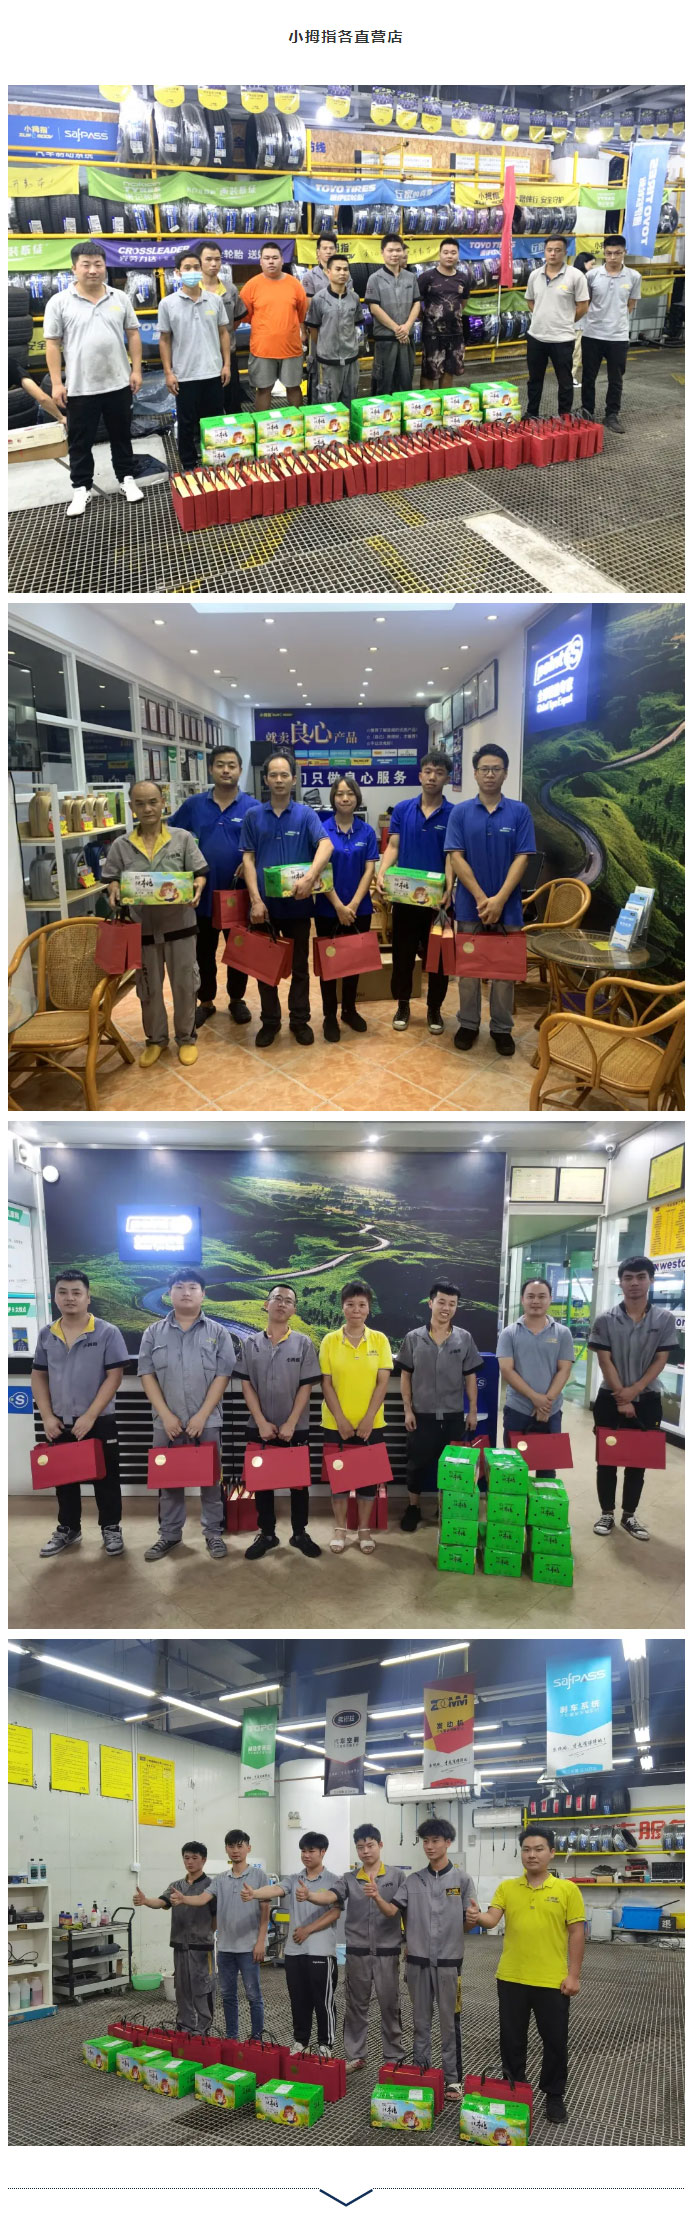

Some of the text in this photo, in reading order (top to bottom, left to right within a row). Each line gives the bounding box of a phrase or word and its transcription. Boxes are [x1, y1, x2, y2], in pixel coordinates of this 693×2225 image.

[315, 184, 377, 192] TOYO TIRES
[265, 721, 358, 745] 就卖良心产品
[15, 1394, 25, 1405] S
[559, 1700, 600, 1713] 刹车系统
[436, 1720, 464, 1730] 发动机
